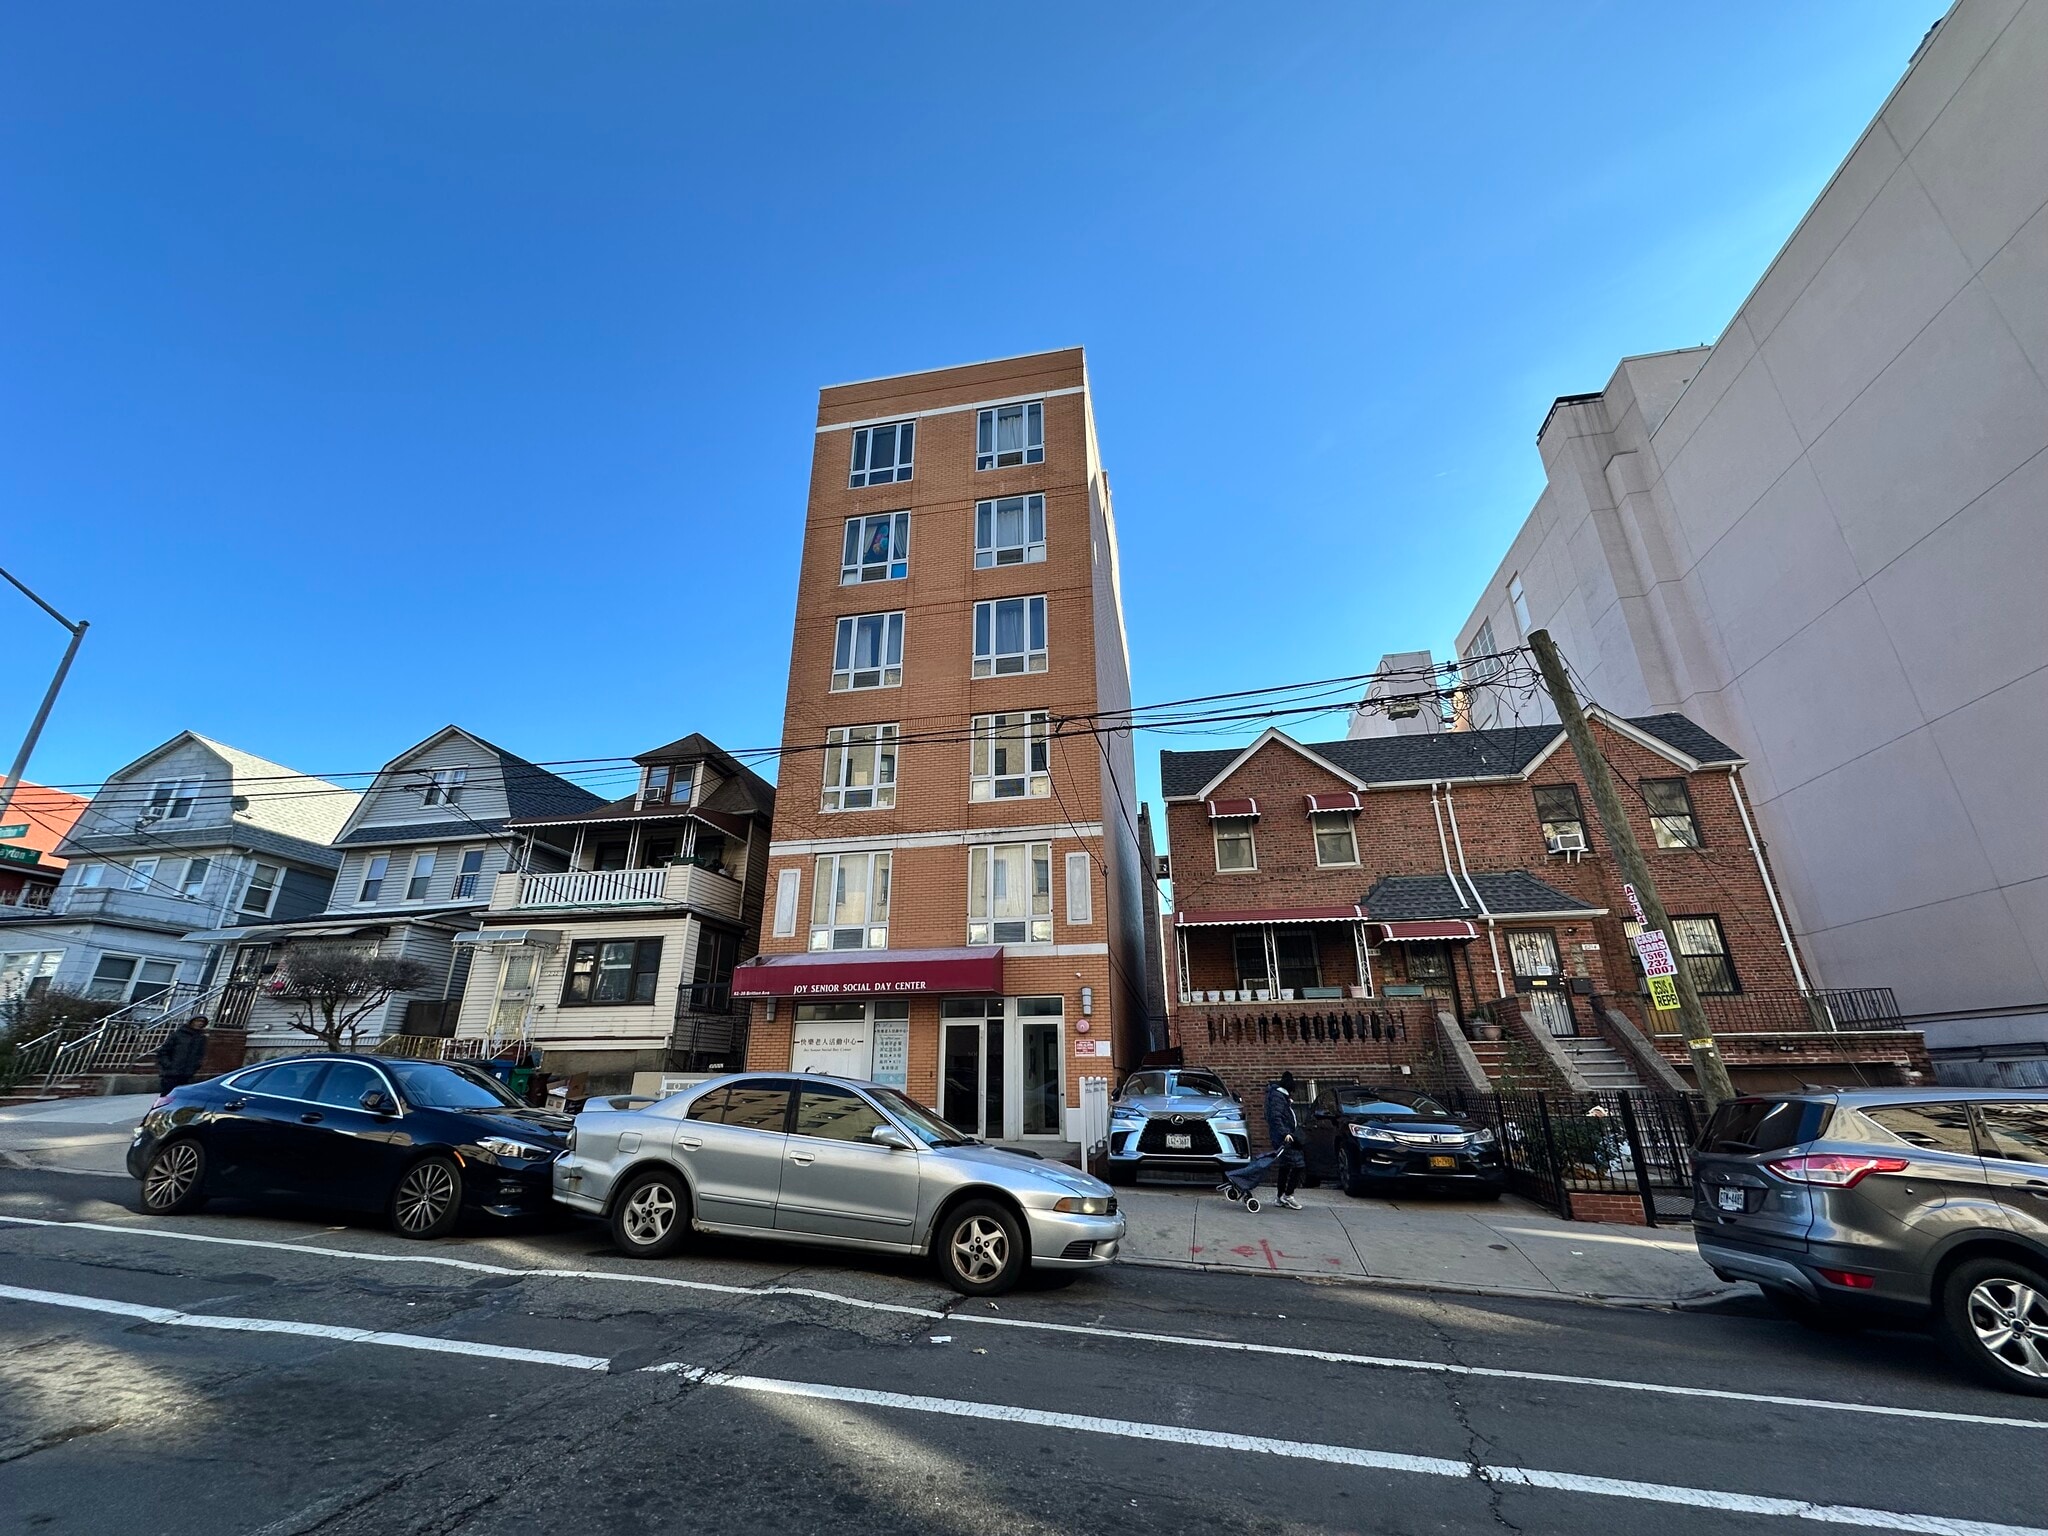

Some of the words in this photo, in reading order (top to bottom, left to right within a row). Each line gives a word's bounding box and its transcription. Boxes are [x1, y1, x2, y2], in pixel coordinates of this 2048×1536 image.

[0, 847, 26, 859] ayton
[1638, 941, 1667, 953] CARS
[1644, 950, 1668, 960] (516)
[1648, 959, 1668, 967] 232
[1648, 965, 1673, 975] 0007
[794, 985, 808, 994] JOY
[811, 984, 840, 993] SENIOR
[843, 983, 871, 992] SOCIAL
[874, 982, 892, 991] DAY
[895, 981, 927, 990] CENTER
